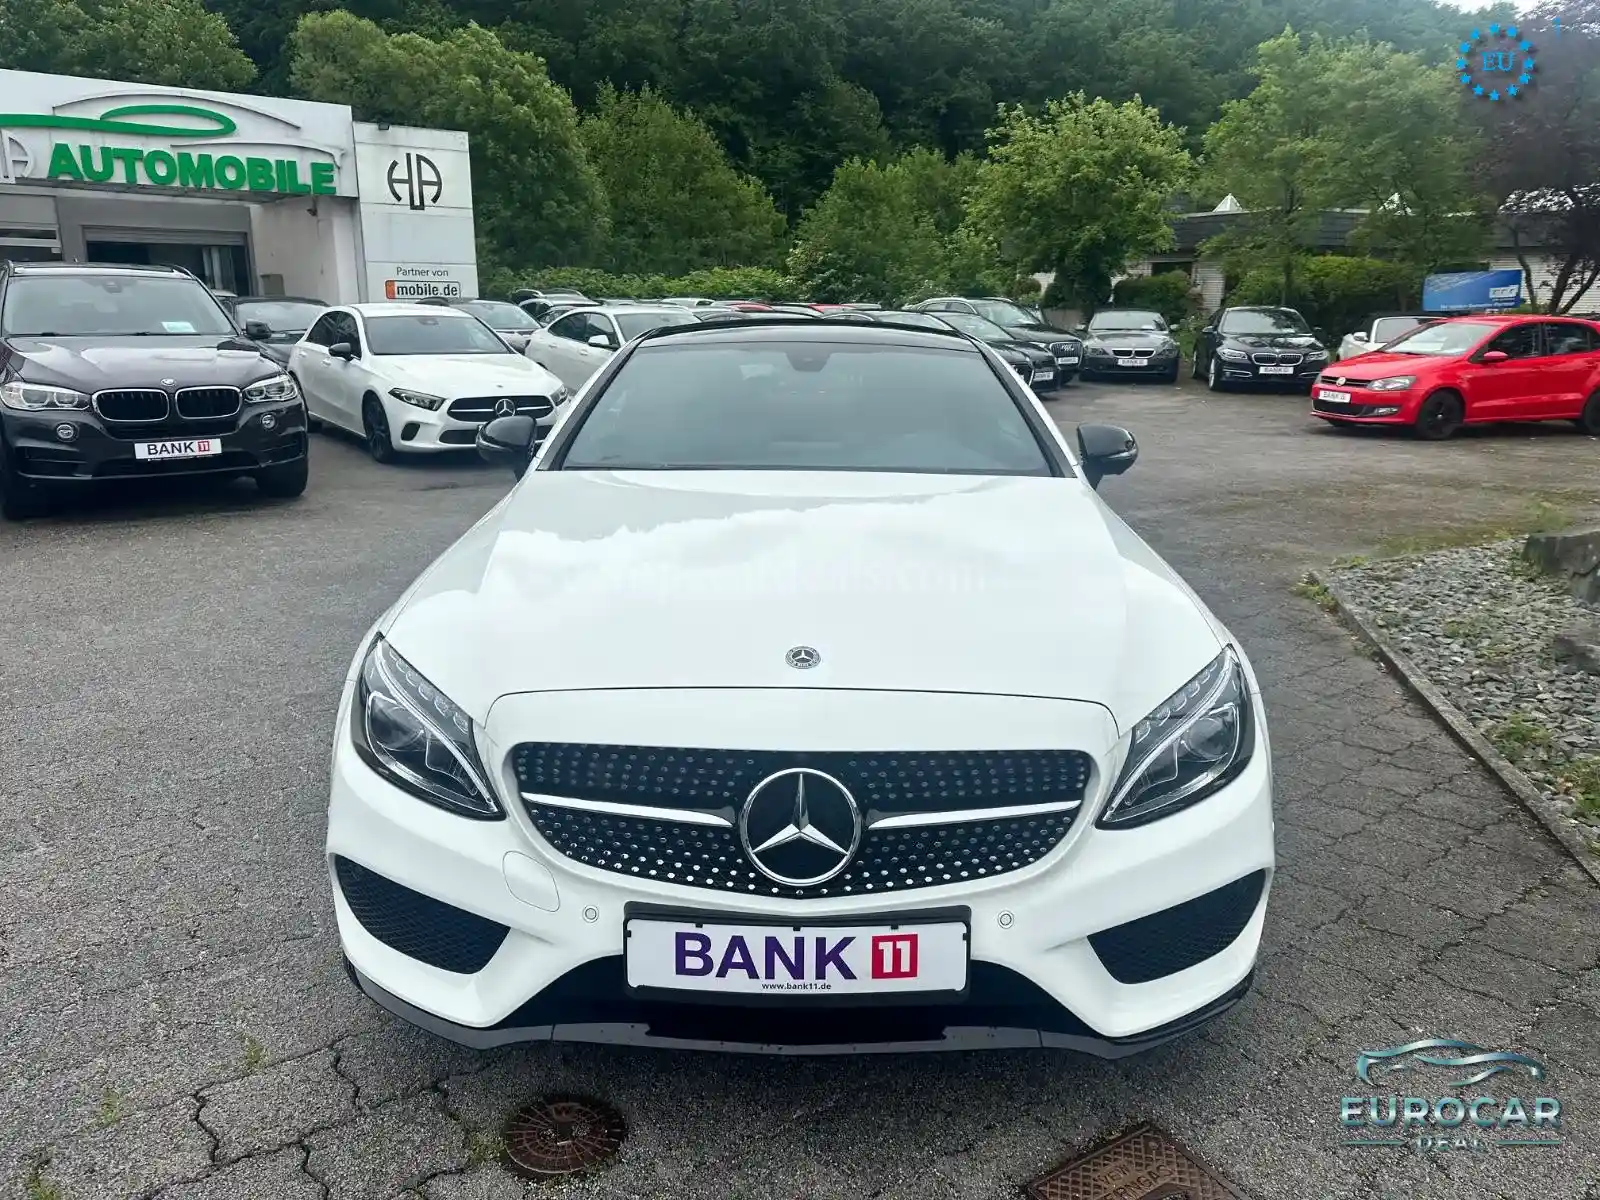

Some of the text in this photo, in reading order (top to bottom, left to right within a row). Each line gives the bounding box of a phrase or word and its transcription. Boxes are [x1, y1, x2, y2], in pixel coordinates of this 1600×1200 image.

[47, 143, 337, 195] AUTOMOBILE
[396, 266, 449, 277] Partner von
[396, 283, 458, 296] mobile.de
[147, 441, 196, 455] BANK
[675, 931, 913, 980] BANK 11
[761, 982, 832, 990] www.bank11.de
